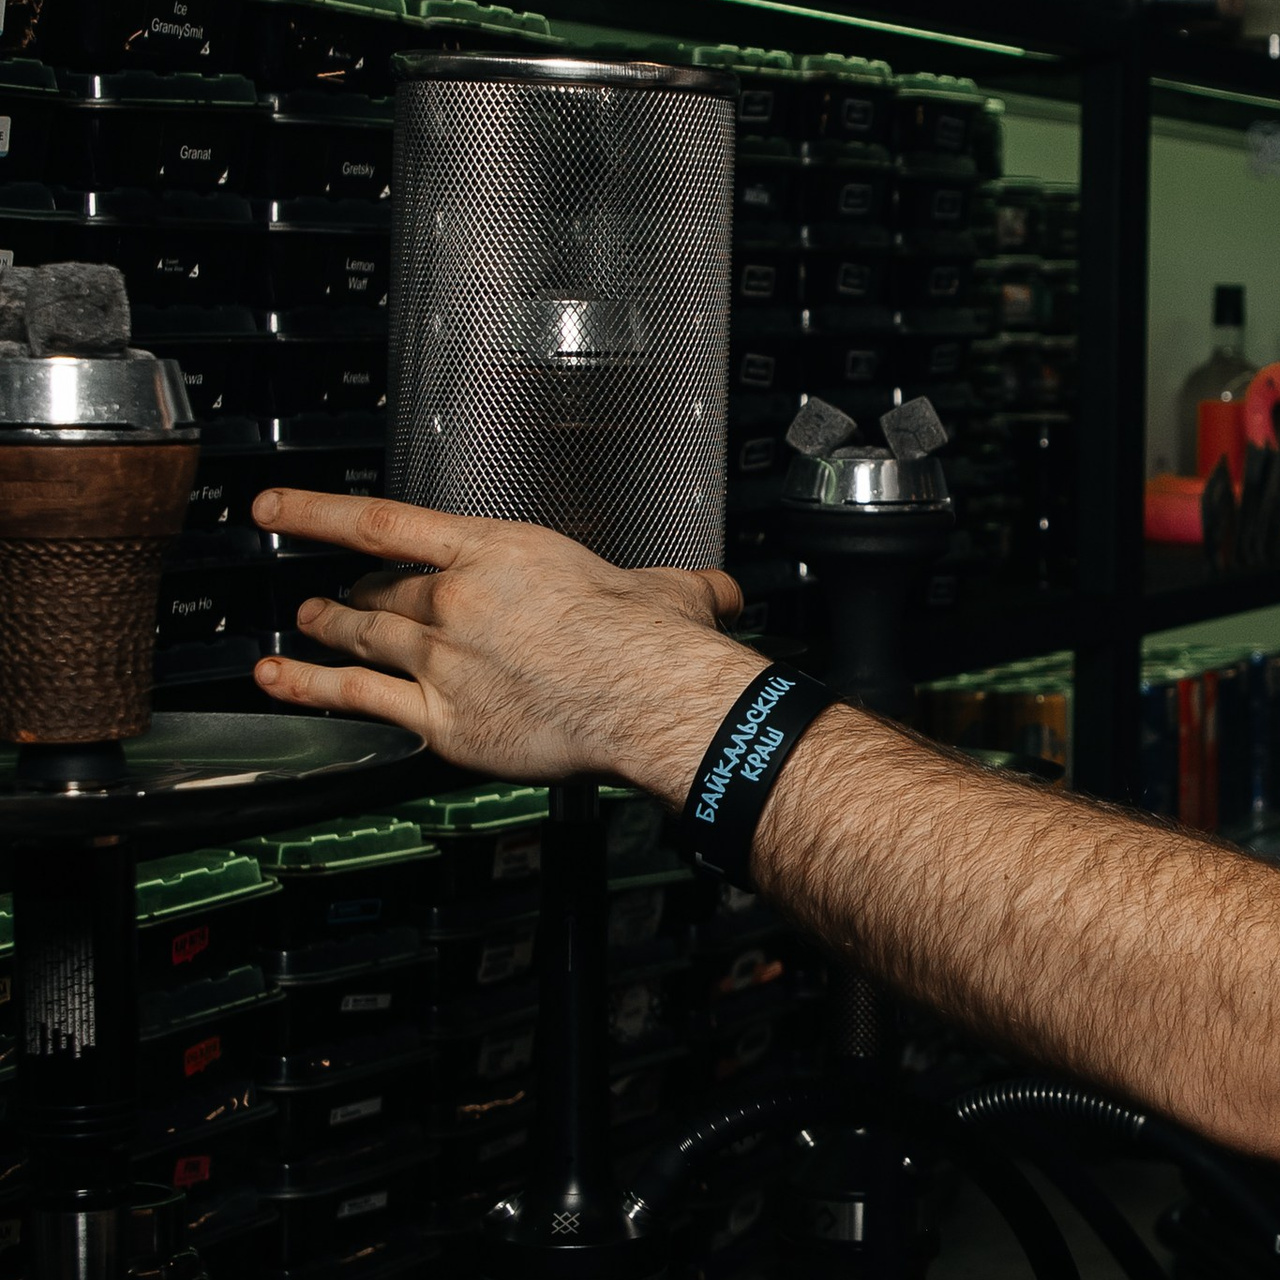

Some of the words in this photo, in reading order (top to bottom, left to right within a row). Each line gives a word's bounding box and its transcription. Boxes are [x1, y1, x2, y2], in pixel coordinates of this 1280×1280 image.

[173, 0, 188, 16] Ice
[180, 145, 211, 160] Granat
[342, 161, 375, 178] Gretsky
[345, 257, 375, 272] Lemon
[342, 371, 370, 385] Kretek
[344, 469, 378, 483] Monkey
[201, 485, 223, 500] Feel
[171, 600, 196, 617] Feya
[695, 676, 796, 823] БАЙКАЛЬСКИЙ
[740, 726, 785, 782] КРАШ
